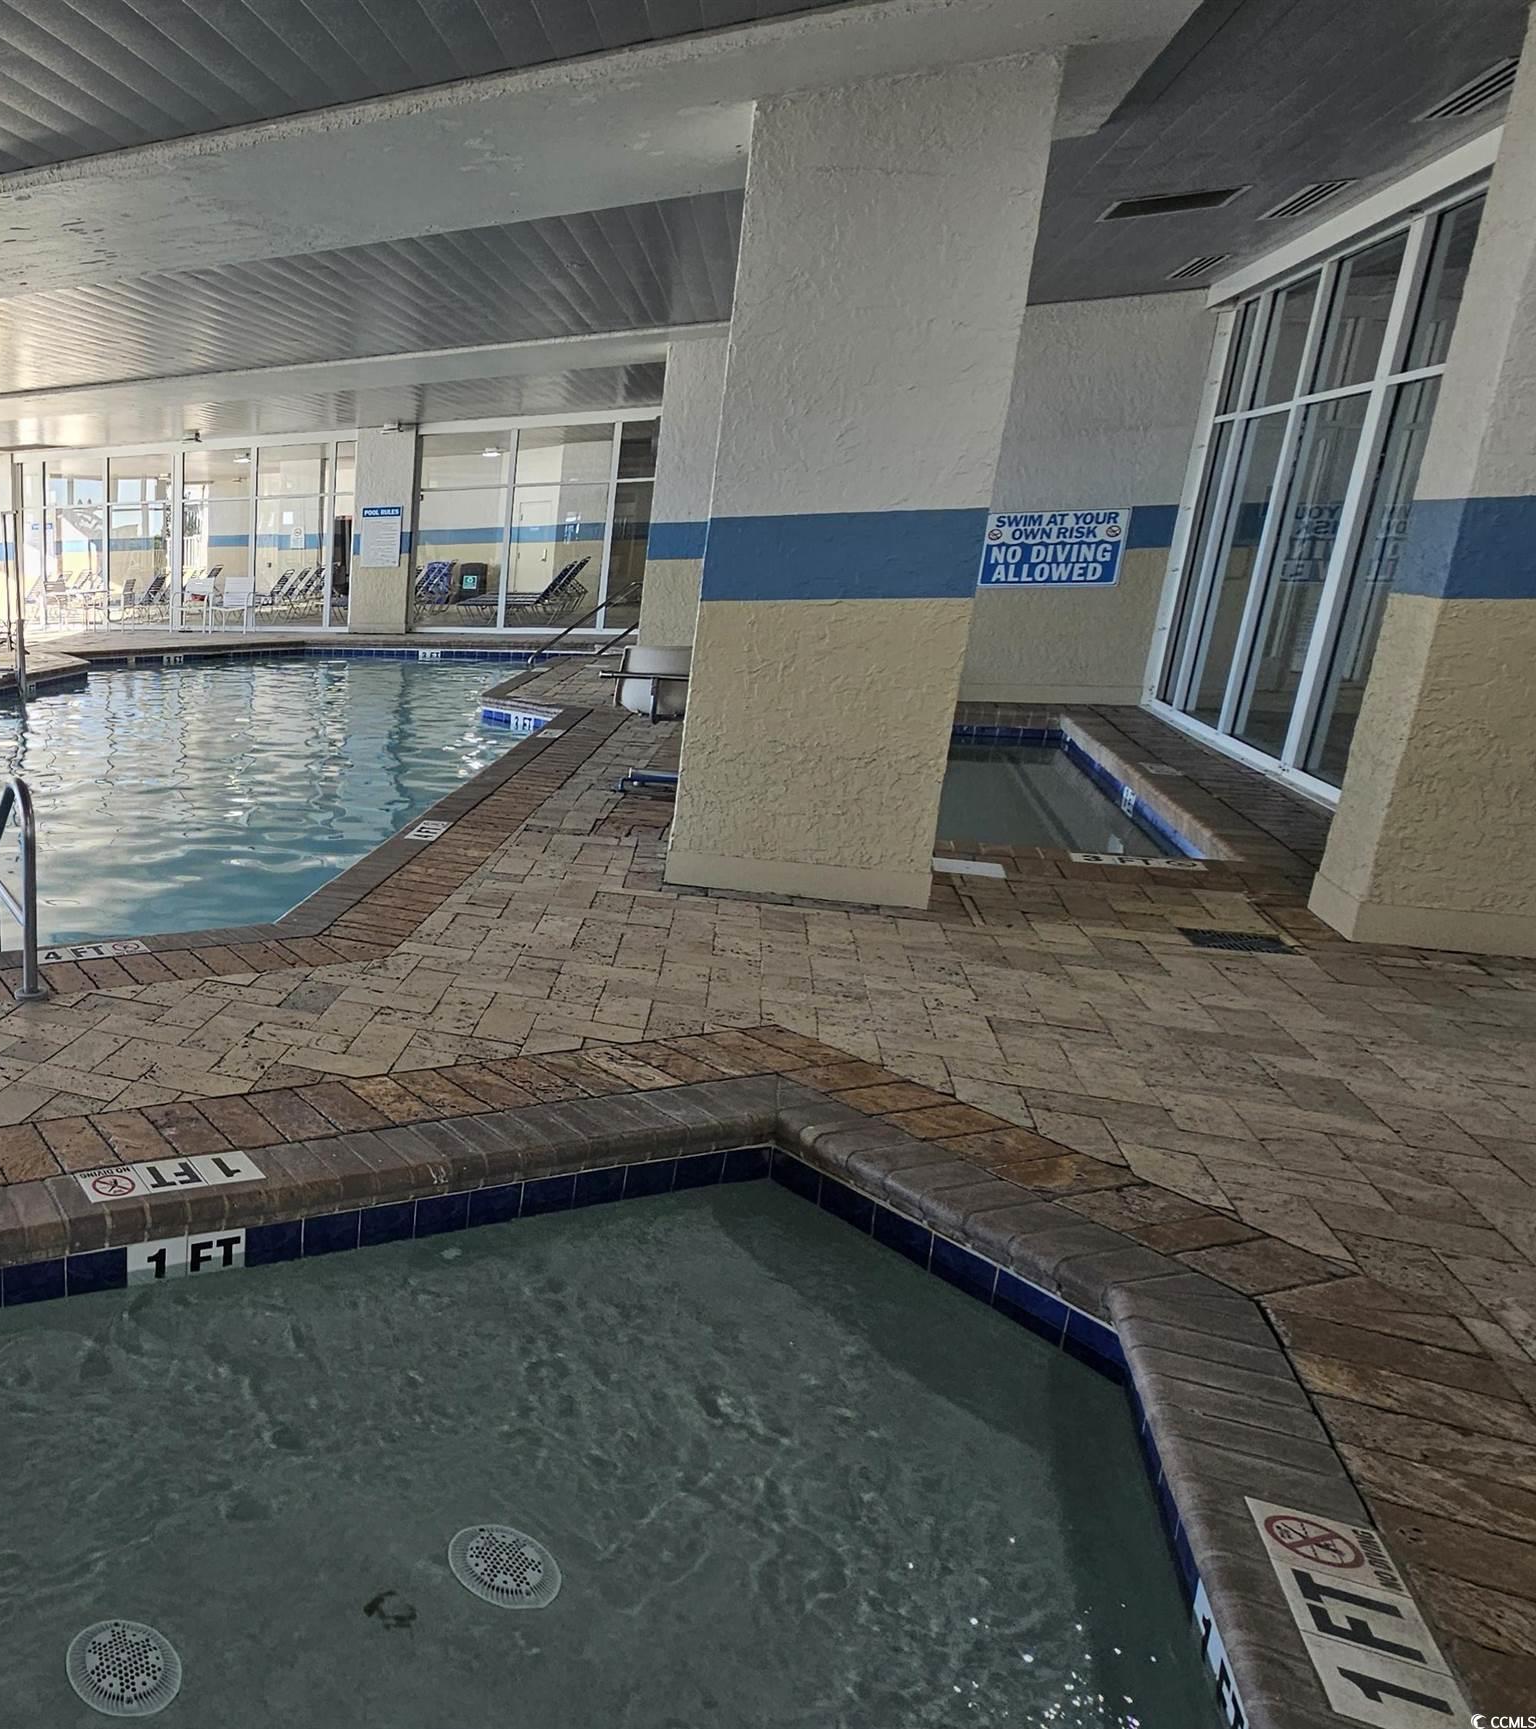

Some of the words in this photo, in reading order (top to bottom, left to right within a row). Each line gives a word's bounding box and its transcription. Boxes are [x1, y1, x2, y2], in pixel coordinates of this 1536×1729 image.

[995, 514, 1042, 528] SWIM
[1046, 513, 1069, 527] AT
[1073, 511, 1119, 526] YOUR
[1011, 528, 1053, 541] OWN
[1056, 526, 1098, 539] RISK
[990, 546, 1022, 564] NO
[1030, 544, 1112, 563] DIVING
[991, 563, 1103, 582] ALLOWED
[523, 717, 532, 730] FT
[1117, 857, 1152, 865] FT
[45, 951, 62, 960] 4
[70, 945, 105, 957] FT
[80, 1169, 113, 1179] DIVING
[116, 1166, 131, 1174] NO
[146, 1162, 202, 1188] FT
[211, 1157, 242, 1178] 1
[147, 1248, 167, 1279] 1
[189, 1236, 241, 1272] FT
[1351, 1528, 1393, 1571] DIVING
[1374, 1570, 1404, 1592] NO
[1291, 1568, 1428, 1664] FT
[1336, 1666, 1455, 1717] 1
